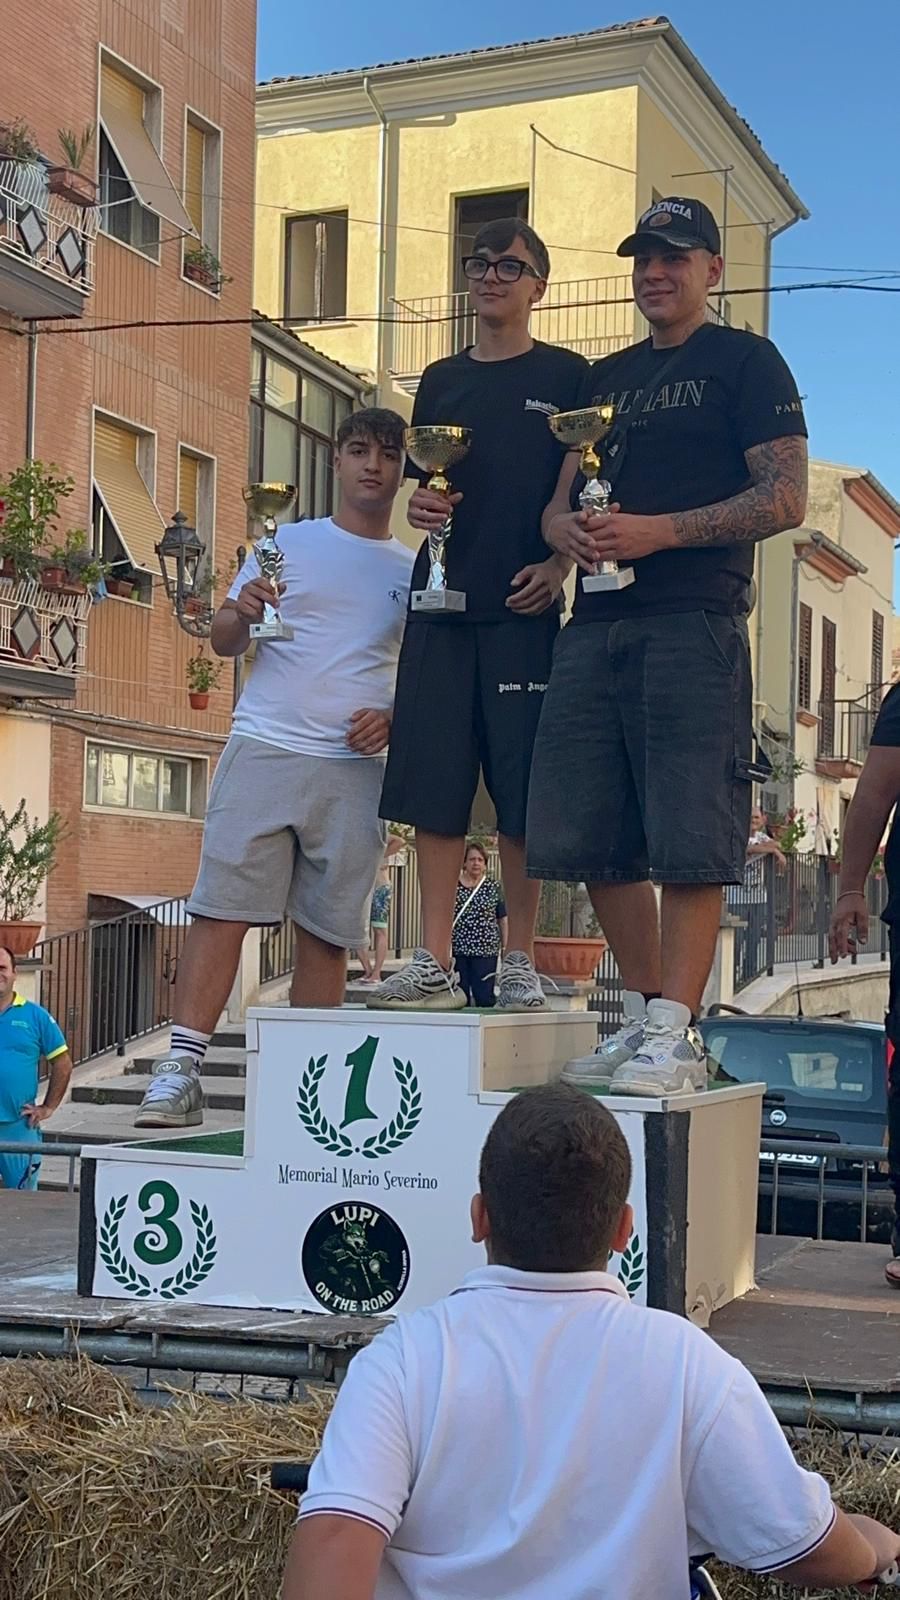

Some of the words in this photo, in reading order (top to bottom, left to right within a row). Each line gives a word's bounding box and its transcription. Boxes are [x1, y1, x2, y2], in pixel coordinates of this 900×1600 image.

[338, 1034, 380, 1130] 1
[278, 1164, 338, 1184] Memorial
[342, 1168, 380, 1188] Mario
[384, 1170, 438, 1191] Severino
[133, 1179, 183, 1266] 3
[330, 1206, 380, 1227] LUPI
[315, 1281, 333, 1302] ON
[332, 1295, 358, 1312] THE
[361, 1289, 394, 1312] ROAD
